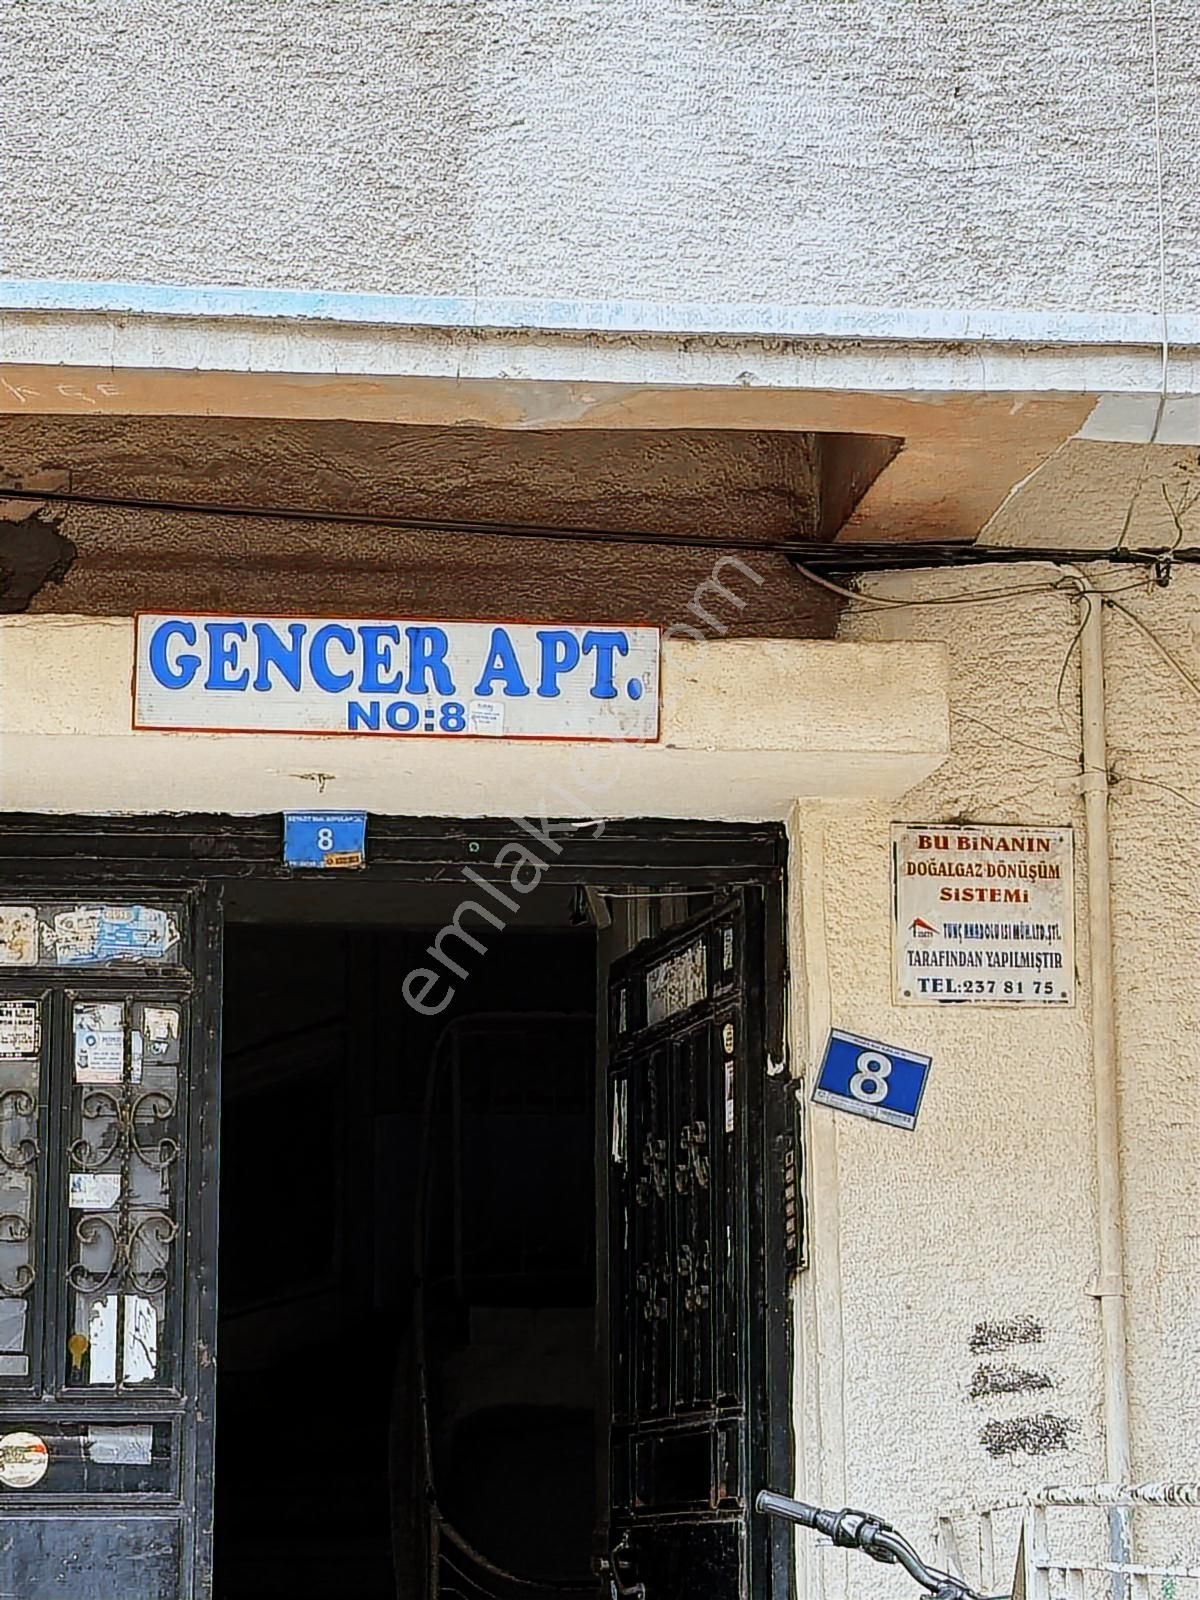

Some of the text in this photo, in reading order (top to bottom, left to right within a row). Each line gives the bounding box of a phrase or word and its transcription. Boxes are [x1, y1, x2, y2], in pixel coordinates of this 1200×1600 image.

[149, 620, 645, 700] GENCER APT.
[346, 700, 466, 732] NO:8
[317, 827, 334, 851] 8
[918, 835, 949, 850] BU
[907, 858, 1061, 883] DOĞALGAZ DÖNÜŞÜM
[907, 951, 1063, 973] TARAFINDAN YAPILMIŞTIR
[918, 979, 996, 993] TEL:237
[849, 1051, 893, 1104] 8
